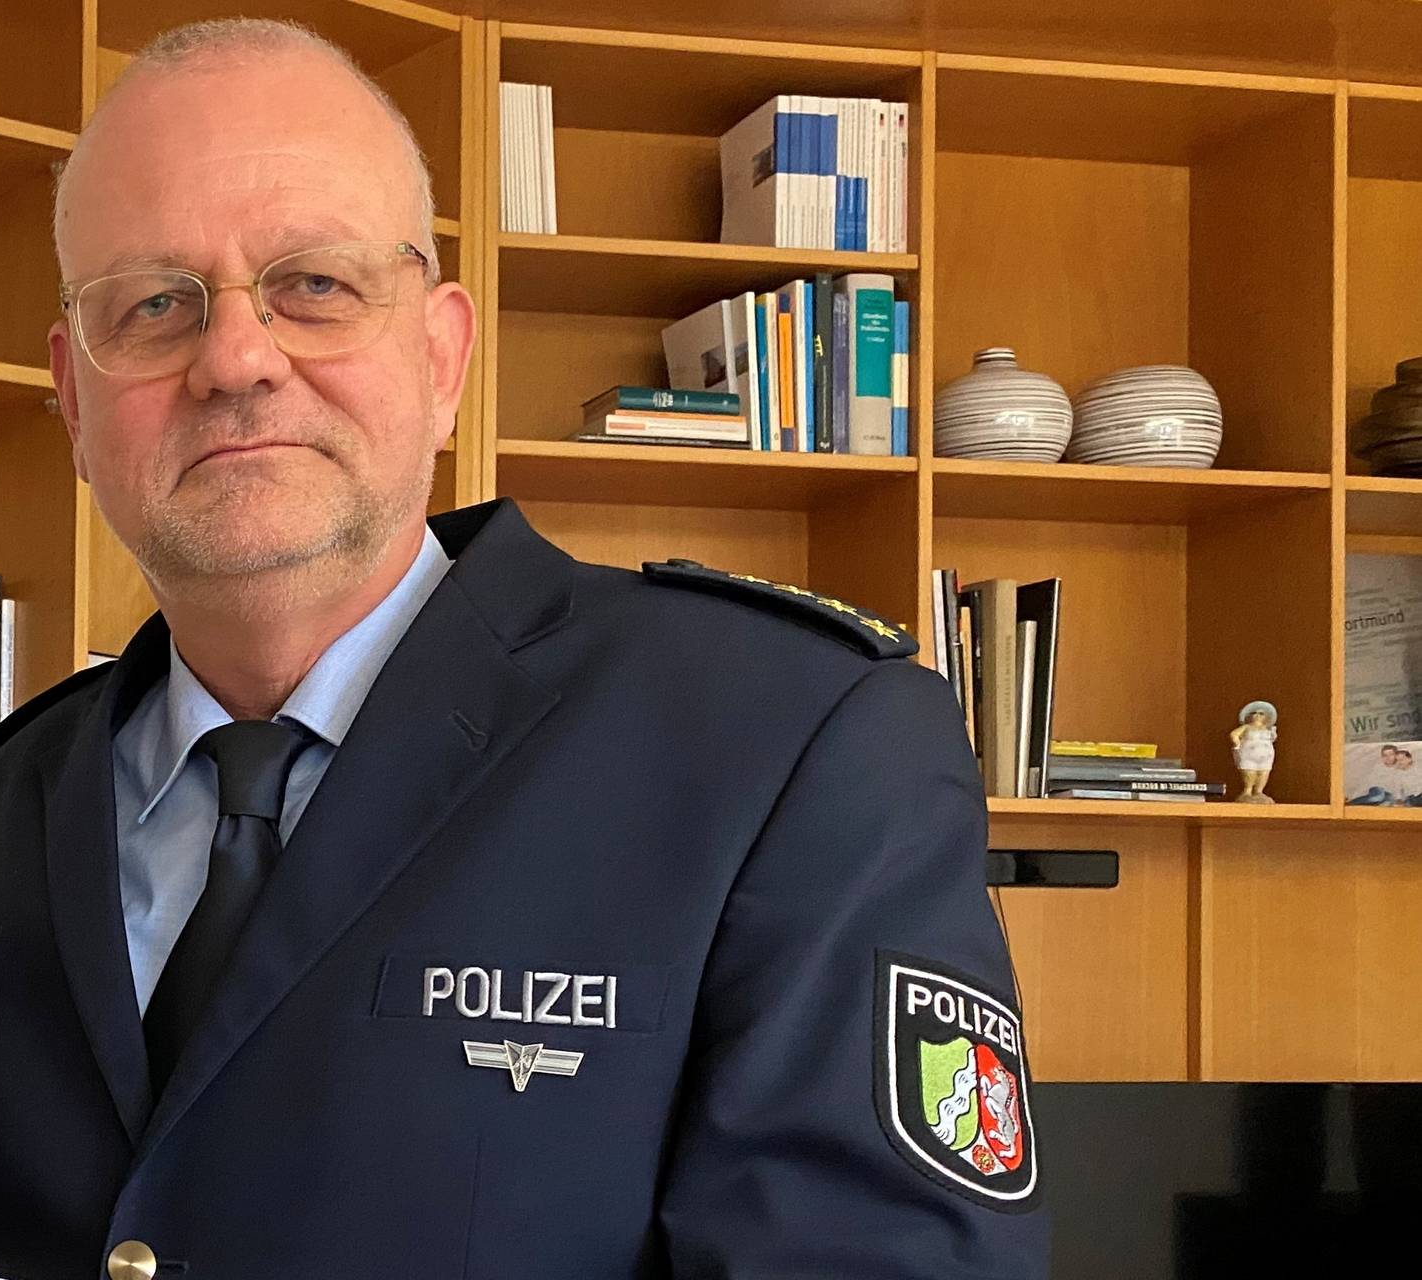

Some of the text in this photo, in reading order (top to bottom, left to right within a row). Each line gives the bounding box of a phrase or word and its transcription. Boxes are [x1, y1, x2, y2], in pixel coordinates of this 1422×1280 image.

[1345, 608, 1405, 631] ortmund
[1350, 715, 1379, 733] Wir
[422, 966, 617, 1029] POLIZEI
[906, 983, 1018, 1056] POLIZEI
